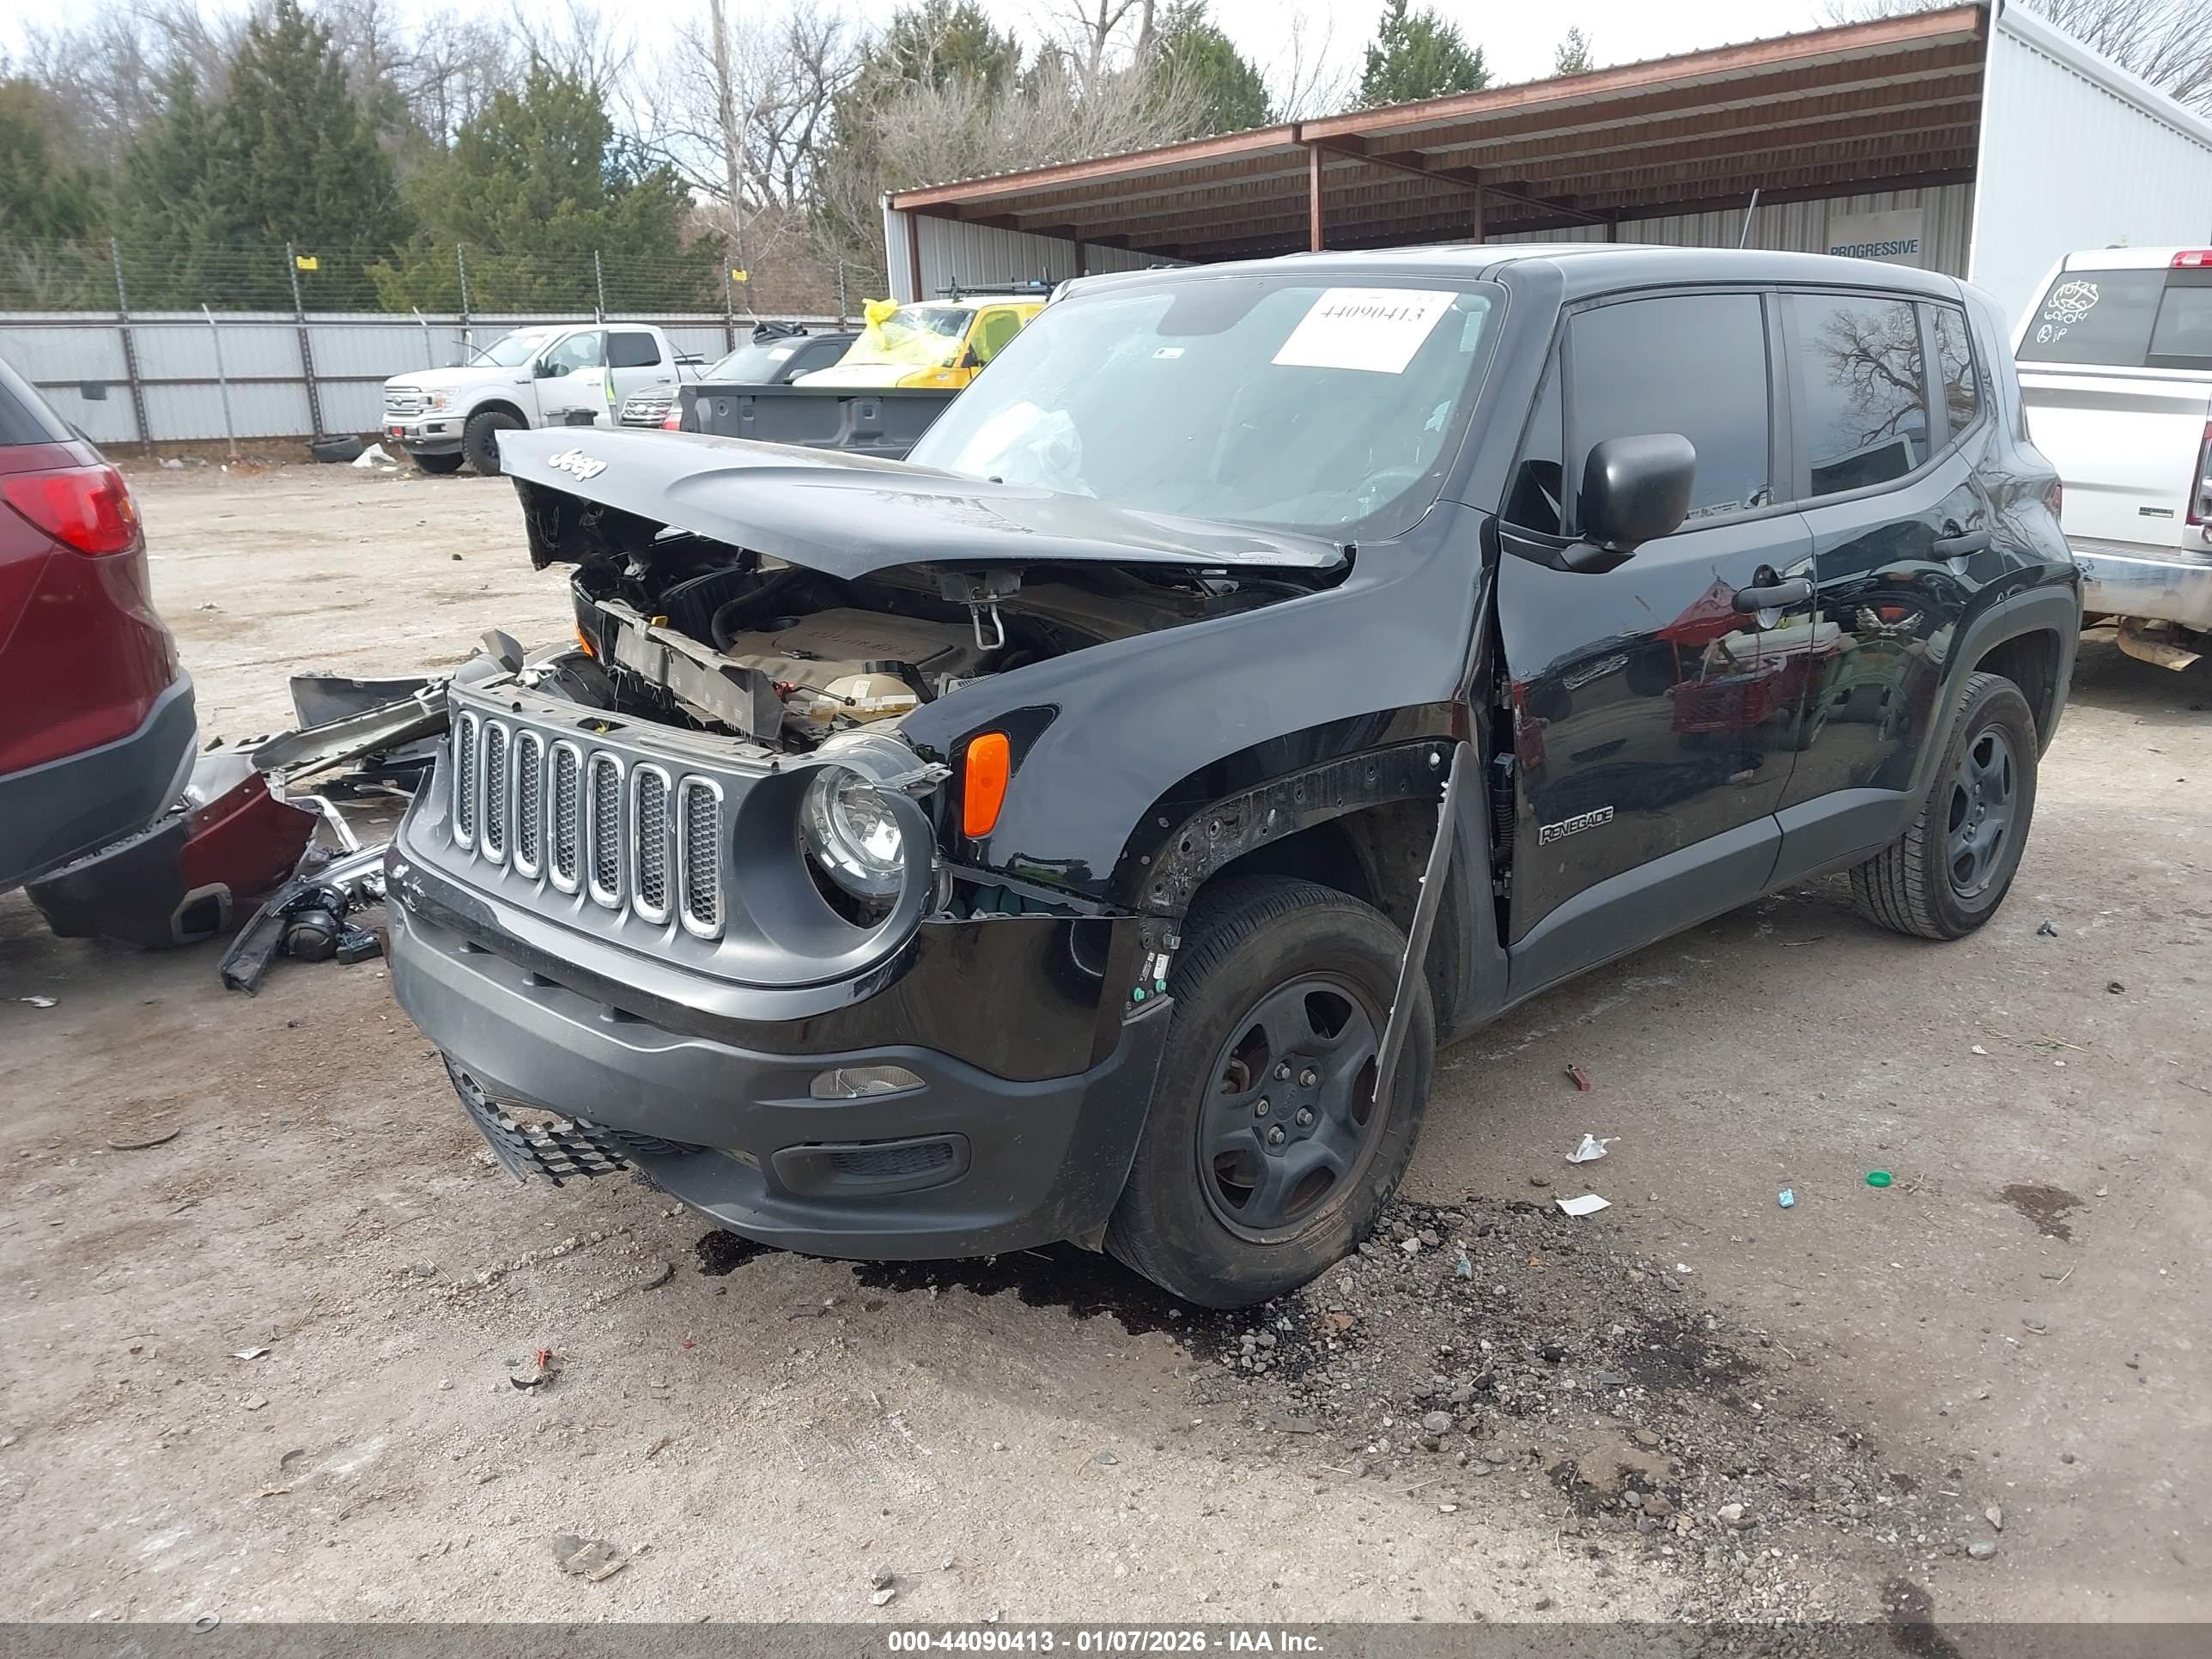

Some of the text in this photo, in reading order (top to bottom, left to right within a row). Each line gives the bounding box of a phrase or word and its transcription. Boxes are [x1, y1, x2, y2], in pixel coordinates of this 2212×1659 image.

[1831, 240, 1919, 258] PROGRESSIVE
[1321, 305, 1425, 322] 44090413
[548, 447, 608, 482] Jeep
[1539, 805, 1614, 846] RENEGADE
